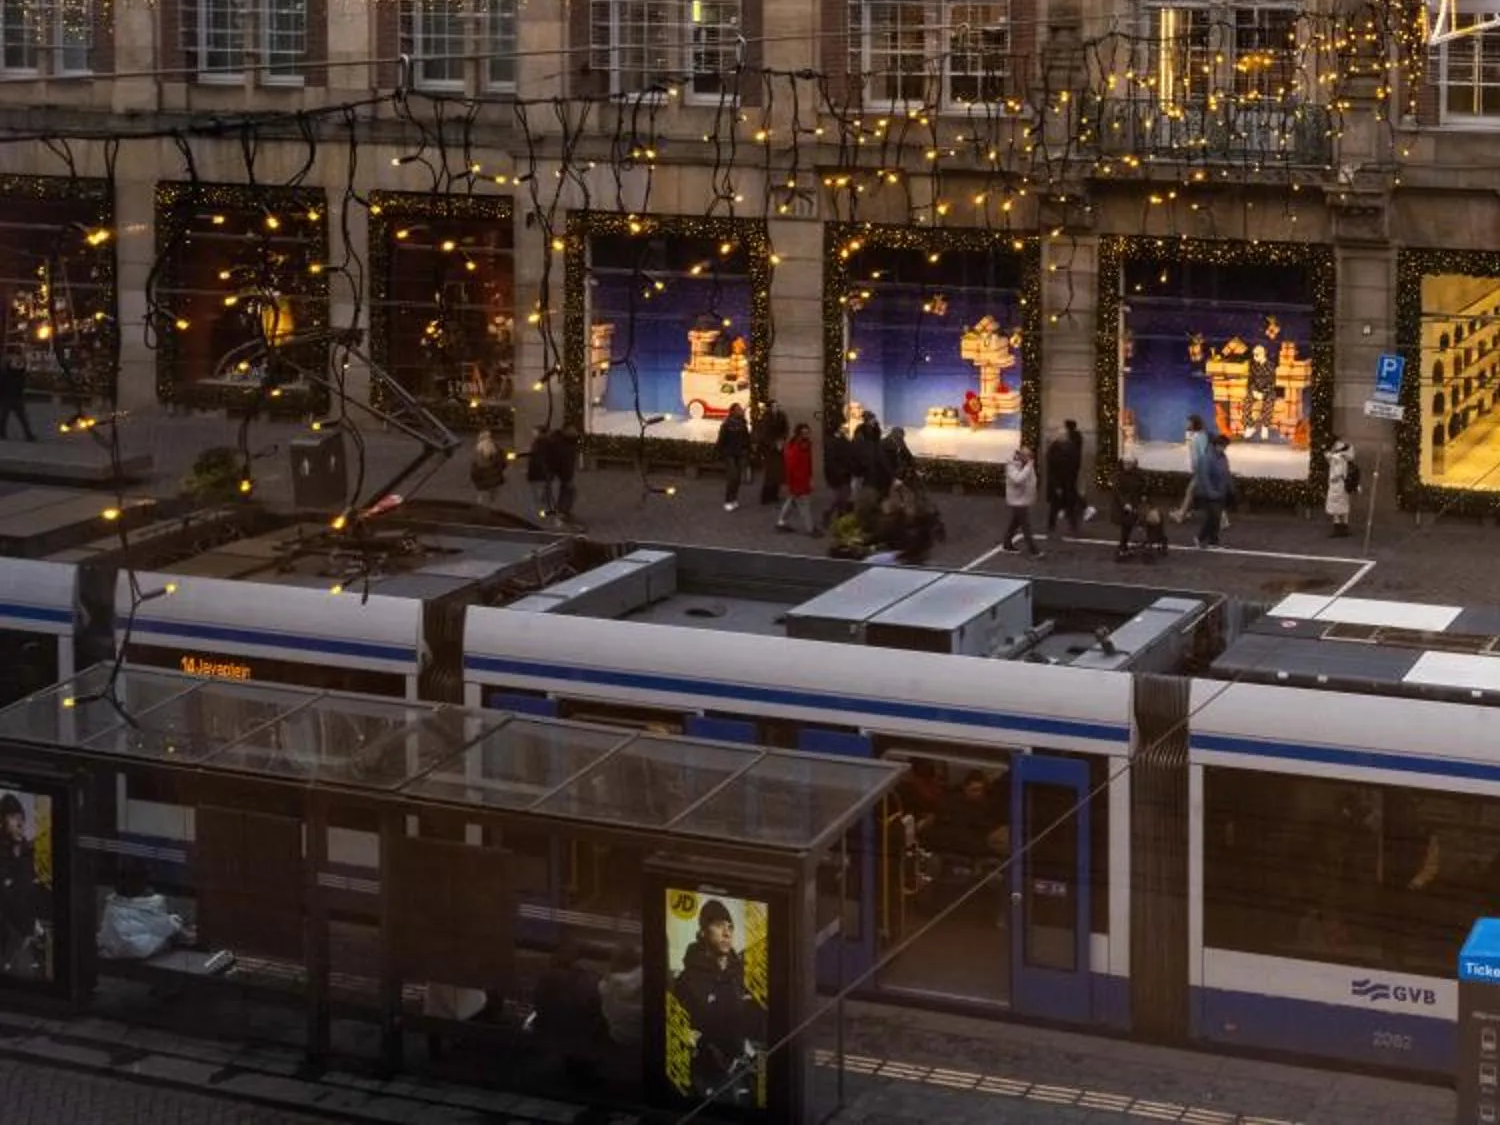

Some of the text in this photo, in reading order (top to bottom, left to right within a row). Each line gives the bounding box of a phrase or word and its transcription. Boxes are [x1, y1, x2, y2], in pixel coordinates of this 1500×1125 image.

[1382, 358, 1397, 378] P
[672, 894, 694, 911] JD
[1392, 985, 1437, 1005] GVB
